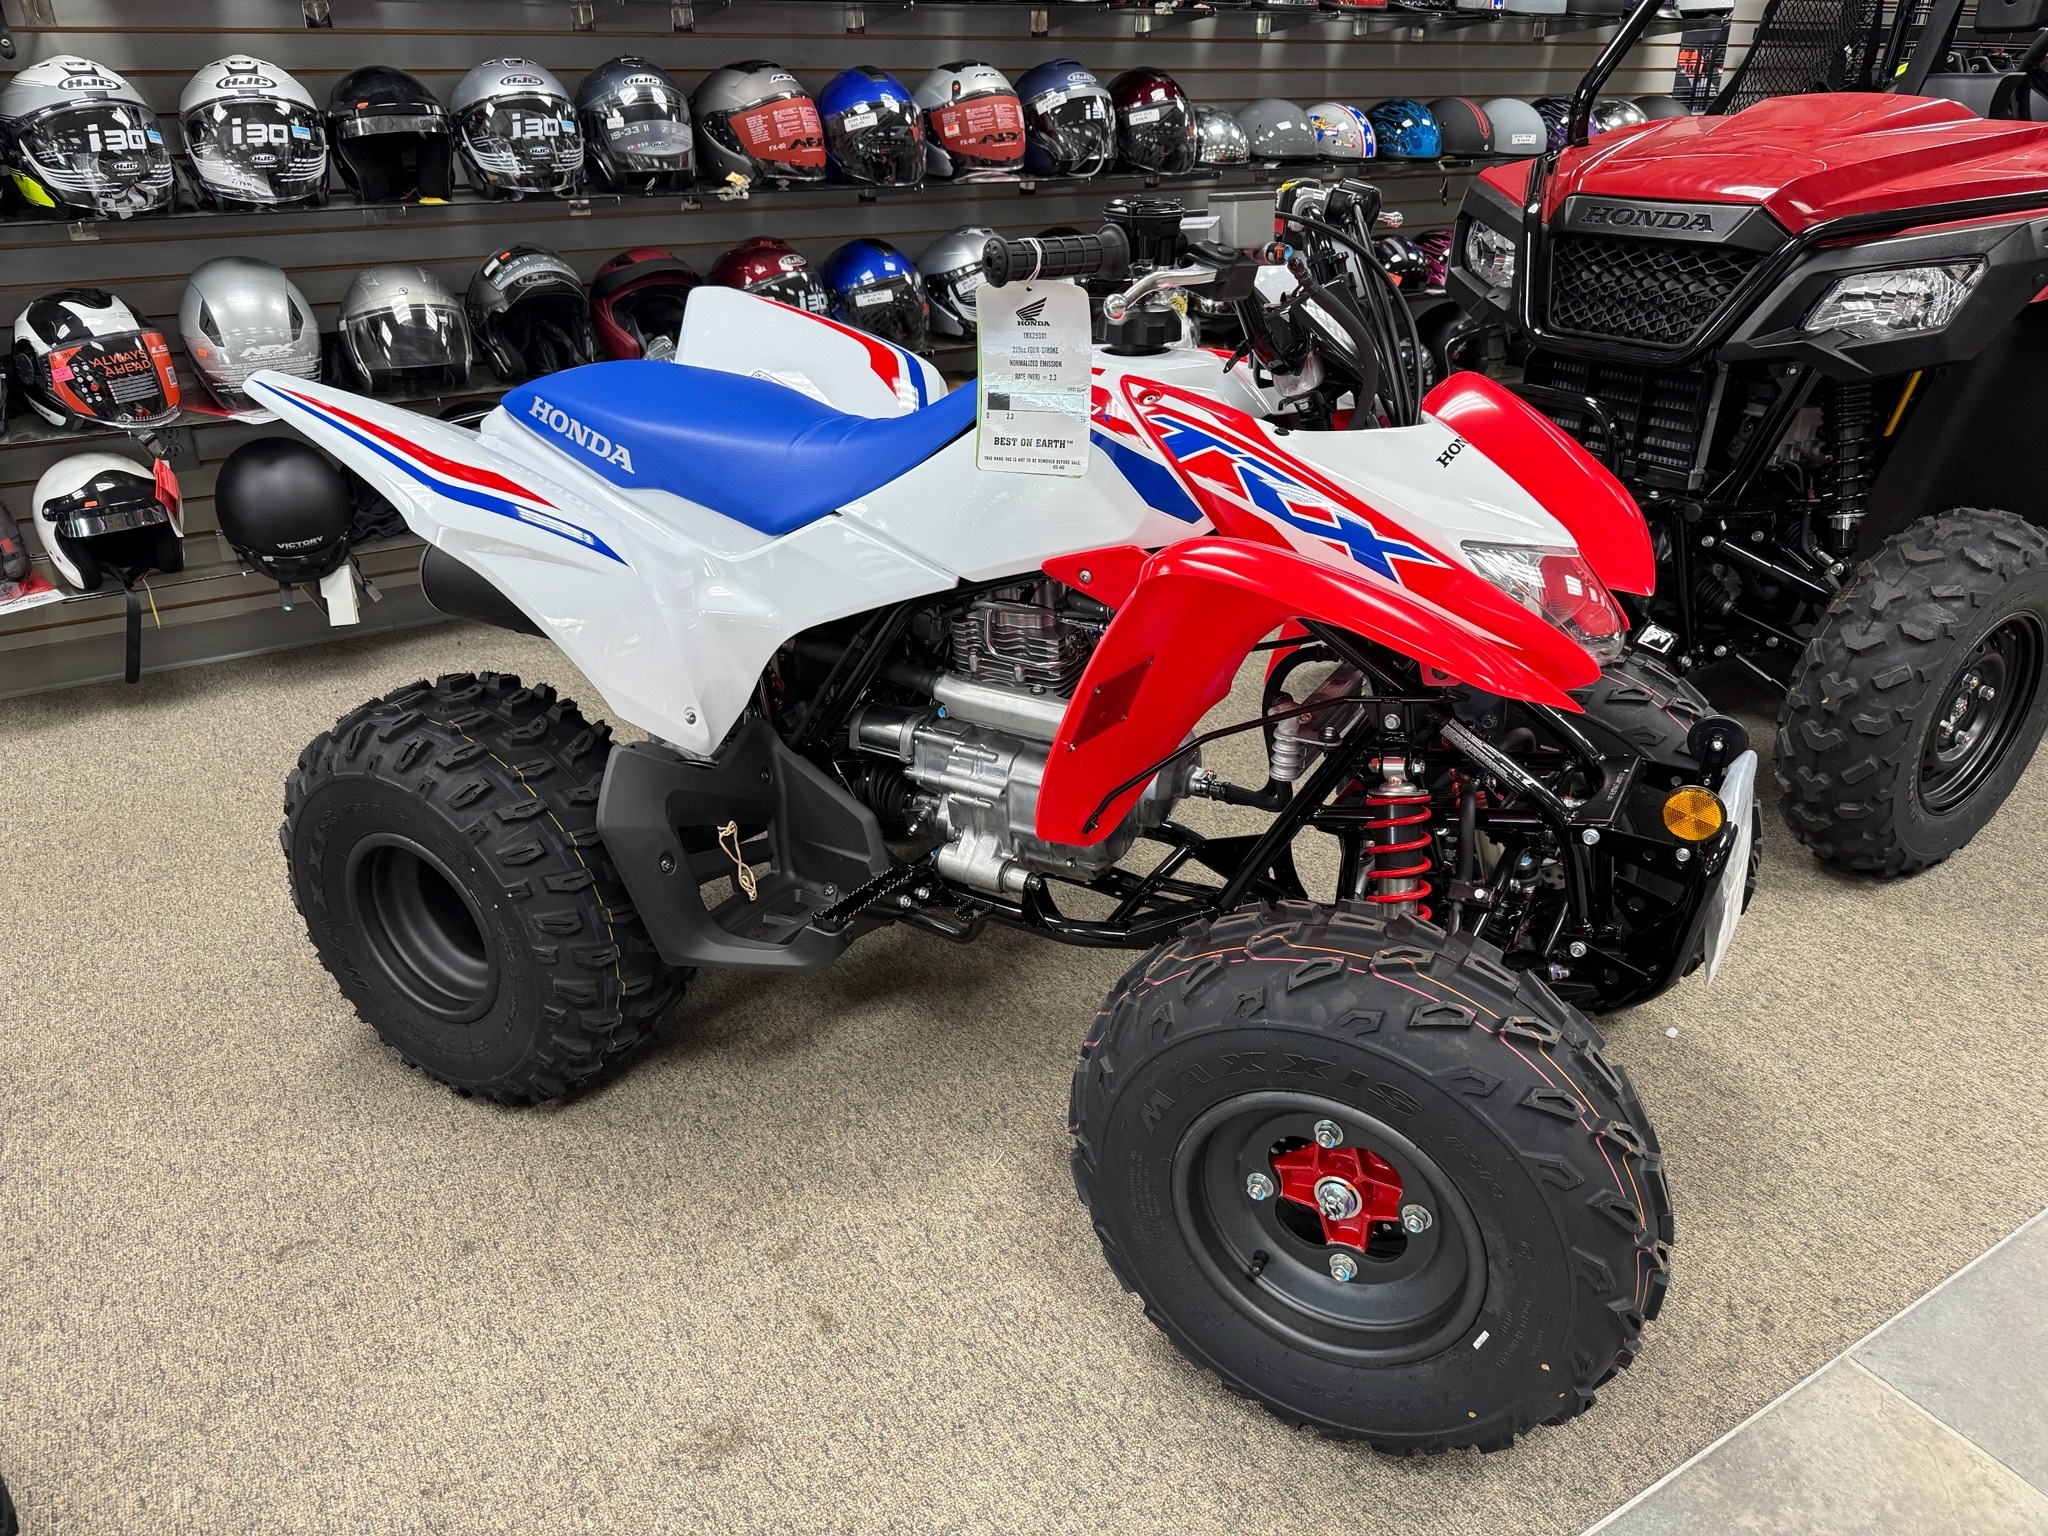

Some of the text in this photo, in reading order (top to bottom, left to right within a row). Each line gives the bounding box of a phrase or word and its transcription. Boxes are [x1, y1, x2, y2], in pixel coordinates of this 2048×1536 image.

[67, 78, 113, 88] HJC
[224, 77, 268, 87] HJC
[507, 76, 539, 84] HJC
[232, 118, 288, 144] i30
[512, 113, 559, 138] i30
[88, 124, 147, 152] i30
[1580, 206, 1714, 232] HONDA
[93, 349, 148, 368] ALWAYS
[239, 342, 296, 357] AFX
[1028, 346, 1058, 354] FOUR-STROKE
[105, 360, 152, 376] AHEAD
[528, 396, 635, 474] HONDA
[994, 437, 1017, 446] BEST
[1020, 438, 1032, 447] ON
[1147, 414, 1453, 590] TRX
[276, 535, 324, 549] VICTORY
[308, 810, 373, 990] MAXXIS
[1140, 1051, 1423, 1136] MAXXIS
